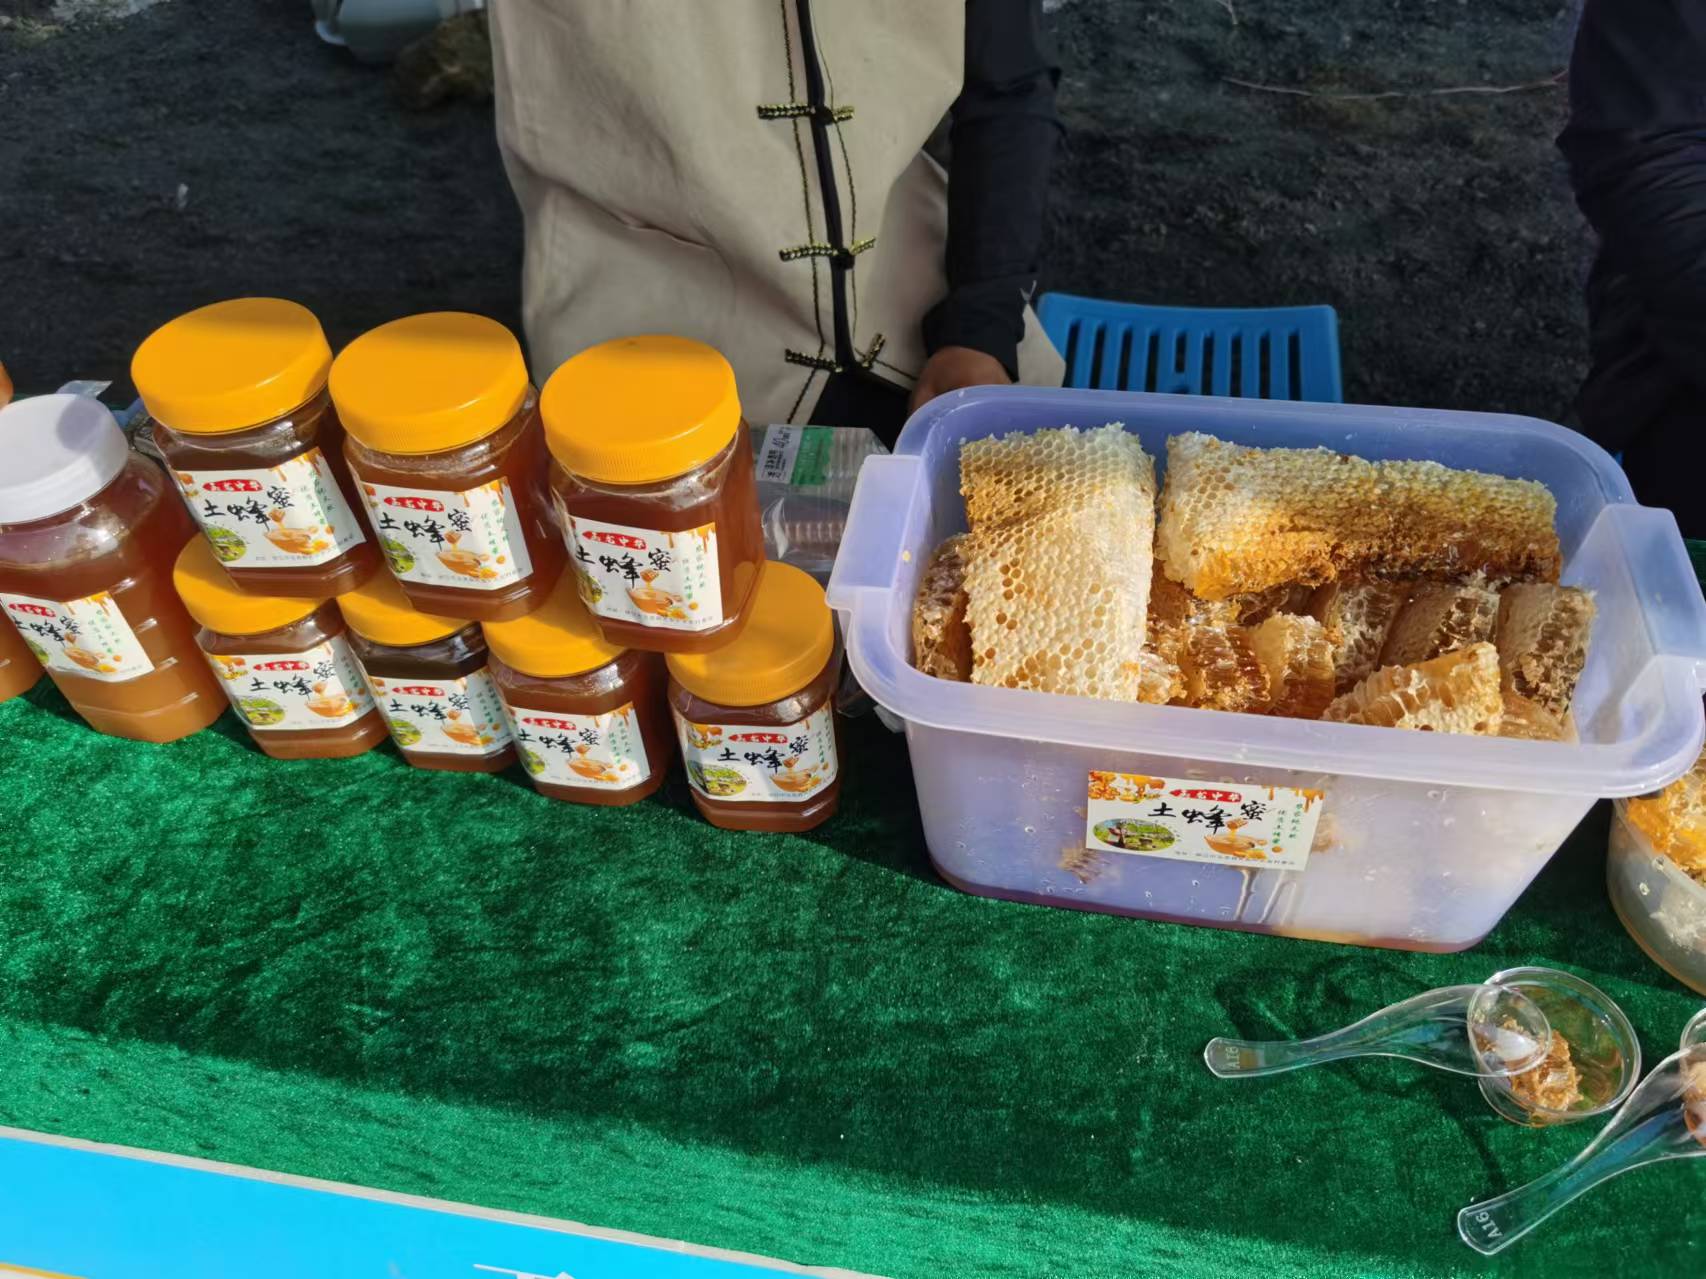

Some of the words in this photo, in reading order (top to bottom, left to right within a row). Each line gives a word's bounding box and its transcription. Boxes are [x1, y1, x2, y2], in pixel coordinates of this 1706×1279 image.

[204, 485, 295, 531] 土蜂蜜
[379, 508, 472, 551] 土蜂蜜
[575, 547, 672, 588] 土蜂蜜
[250, 659, 336, 700] 土蜂蜜
[389, 692, 471, 725] 土蜂蜜
[518, 727, 600, 758] 土蜂蜜
[717, 735, 809, 773] 土蜂蜜
[1147, 800, 1268, 834] 土蜂蜜
[1475, 1211, 1503, 1238] A16
